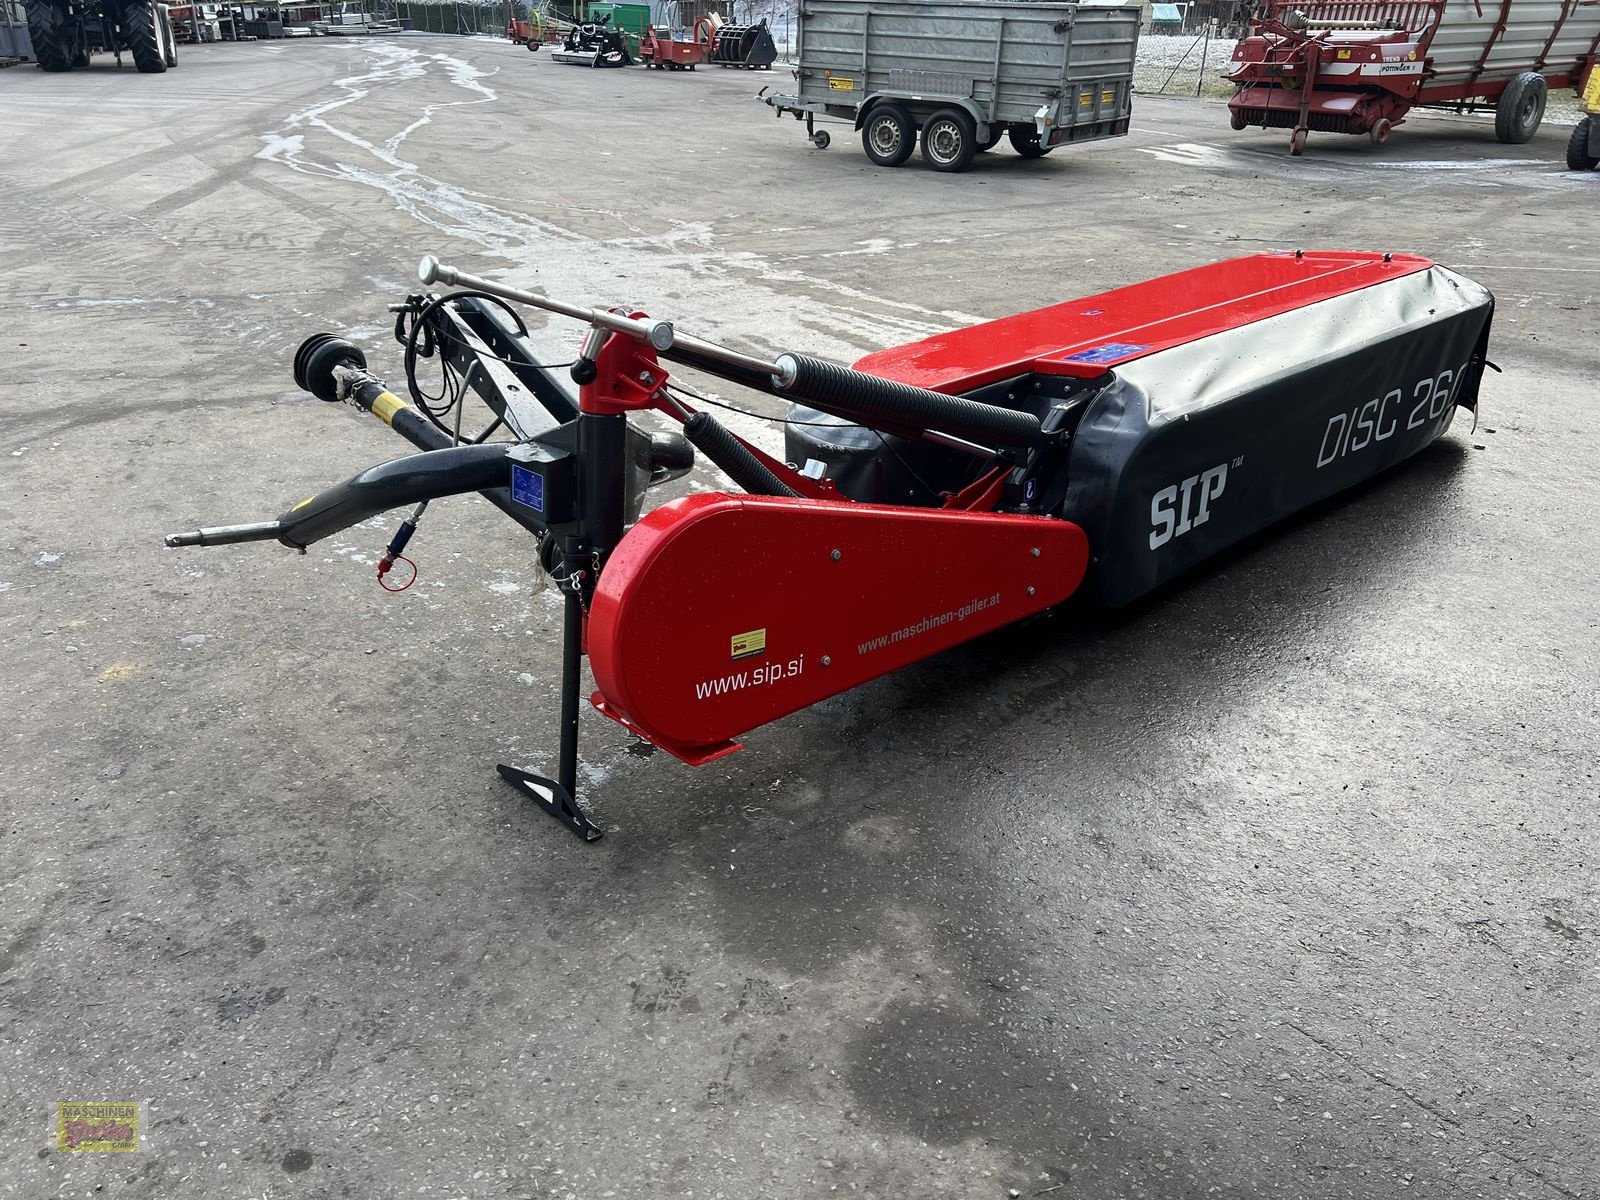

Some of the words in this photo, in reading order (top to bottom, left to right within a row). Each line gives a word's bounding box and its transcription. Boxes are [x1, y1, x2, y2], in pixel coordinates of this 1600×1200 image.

[1316, 388, 1402, 469] DISC
[1149, 463, 1228, 551] SIP
[857, 592, 1001, 655] www.maschinen-gailer.at
[696, 653, 804, 700] www.sip.si
